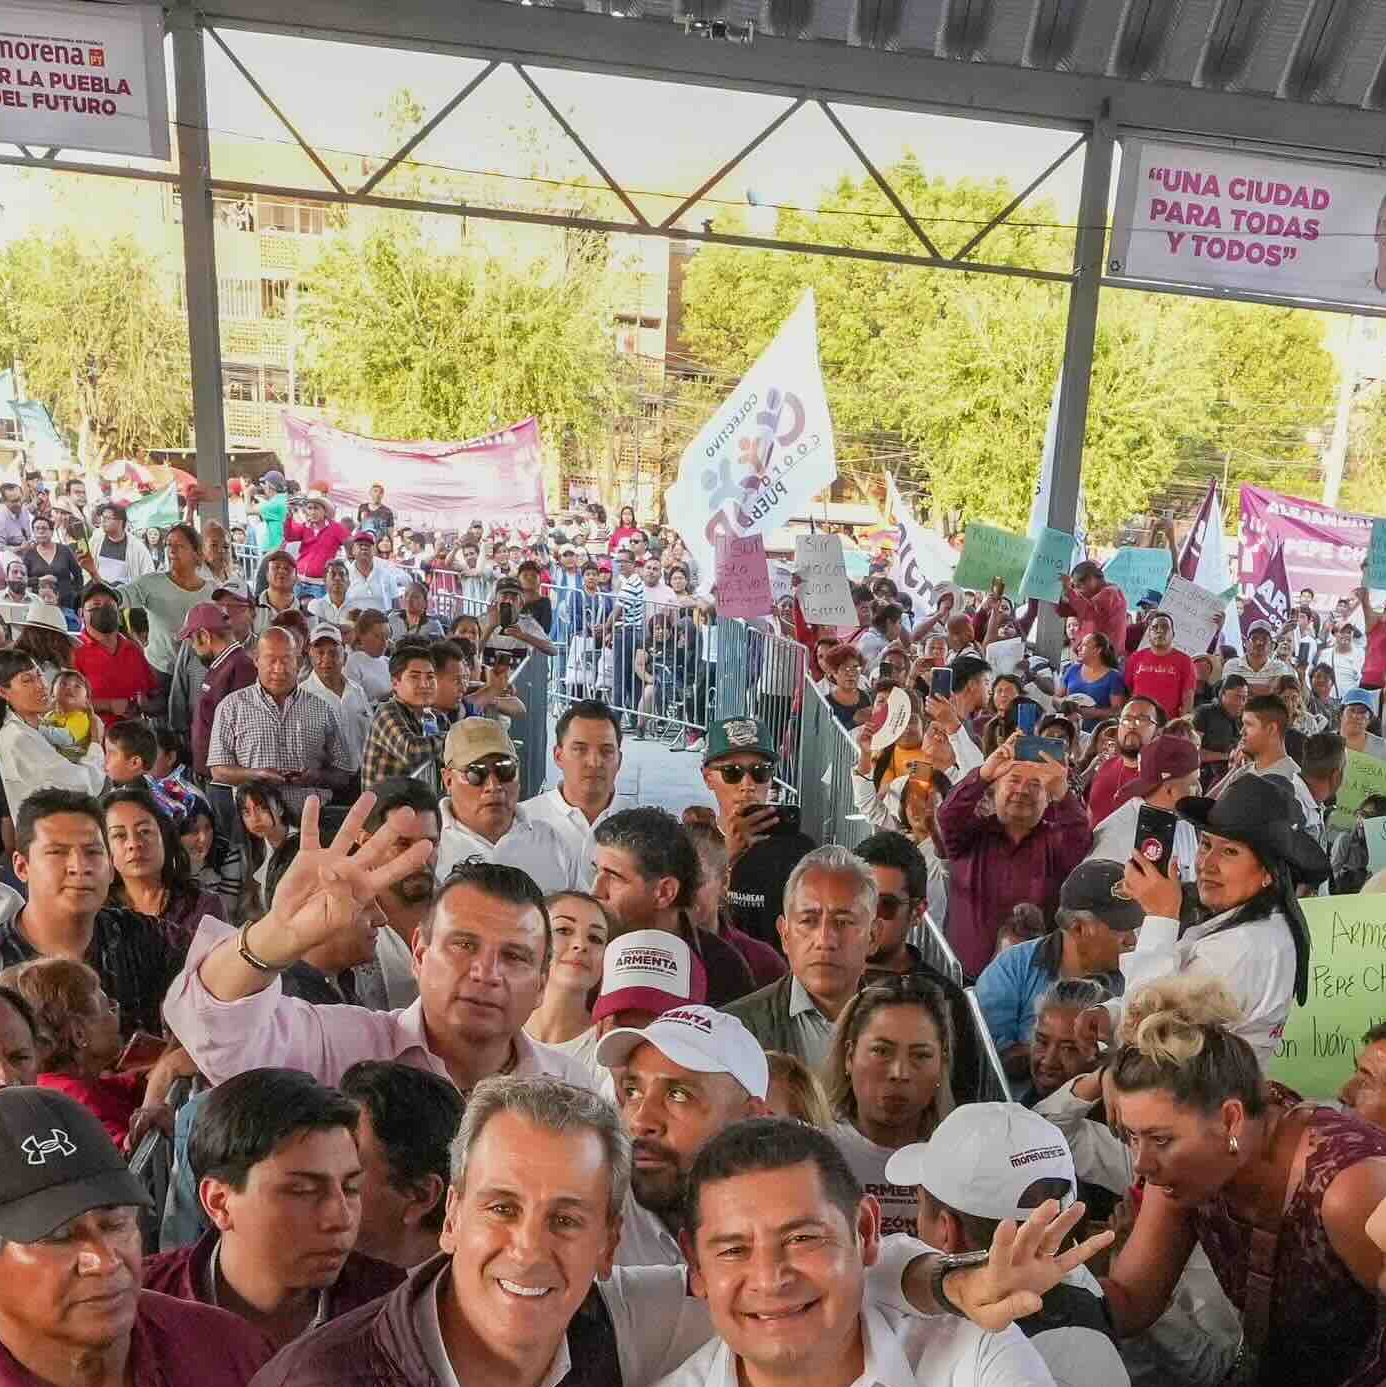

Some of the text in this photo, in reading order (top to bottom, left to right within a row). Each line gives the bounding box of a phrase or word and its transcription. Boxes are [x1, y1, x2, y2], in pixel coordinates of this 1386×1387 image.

[16, 70, 44, 88] LA
[49, 72, 132, 96] PUEBLA
[32, 92, 116, 116] FUTURO
[1228, 178, 1330, 211] CIUDAD
[1150, 198, 1319, 241] PARA TODAS
[1167, 231, 1186, 253] Y
[615, 955, 678, 971] ARMENTA
